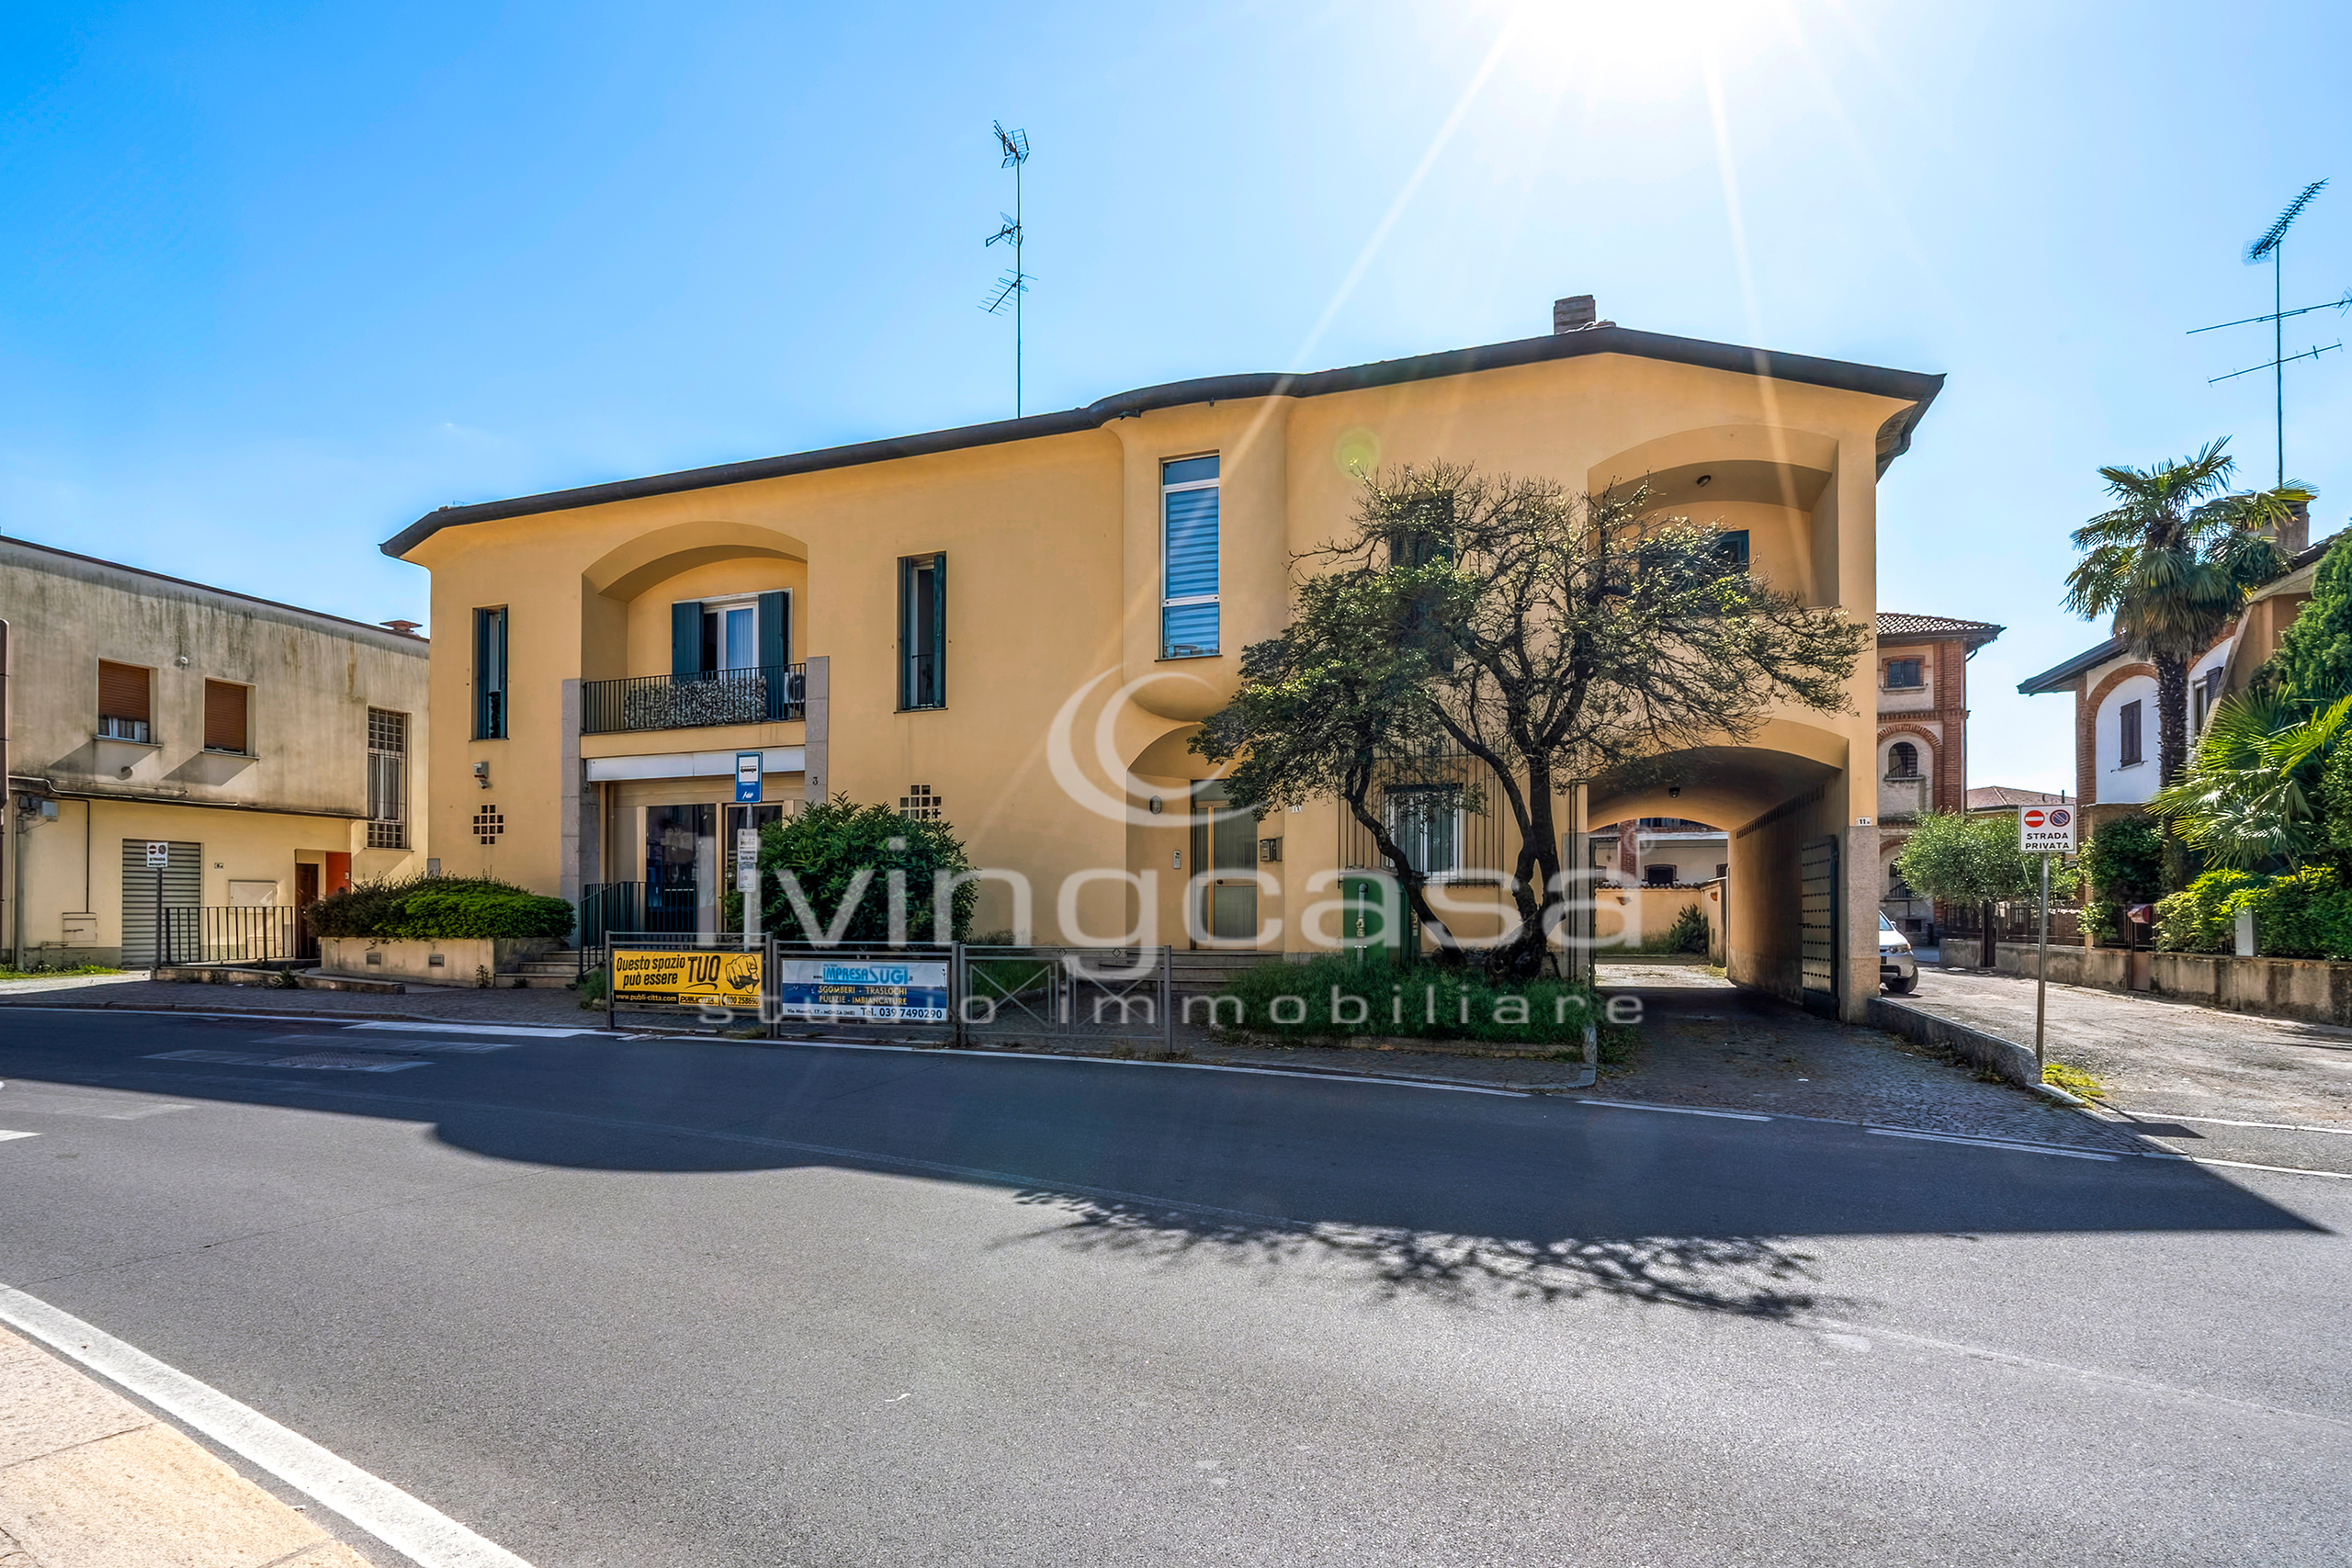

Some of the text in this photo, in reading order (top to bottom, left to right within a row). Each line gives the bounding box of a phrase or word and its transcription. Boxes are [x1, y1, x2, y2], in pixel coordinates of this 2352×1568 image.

[812, 776, 819, 785] 3
[616, 953, 685, 972] Questo spazio
[687, 954, 721, 983] TUO
[622, 971, 678, 989] può essere
[822, 967, 869, 981] IMPRESA
[869, 965, 909, 985] SUGI
[818, 986, 855, 994] SGOMBERI
[865, 987, 908, 996] TRASLOCHI
[616, 993, 677, 1002] www.publi-citta.com
[819, 995, 846, 1003] PULIZIE
[852, 997, 908, 1006] IMBIANCATURE
[860, 1007, 943, 1019] Tel. 039 7490290
